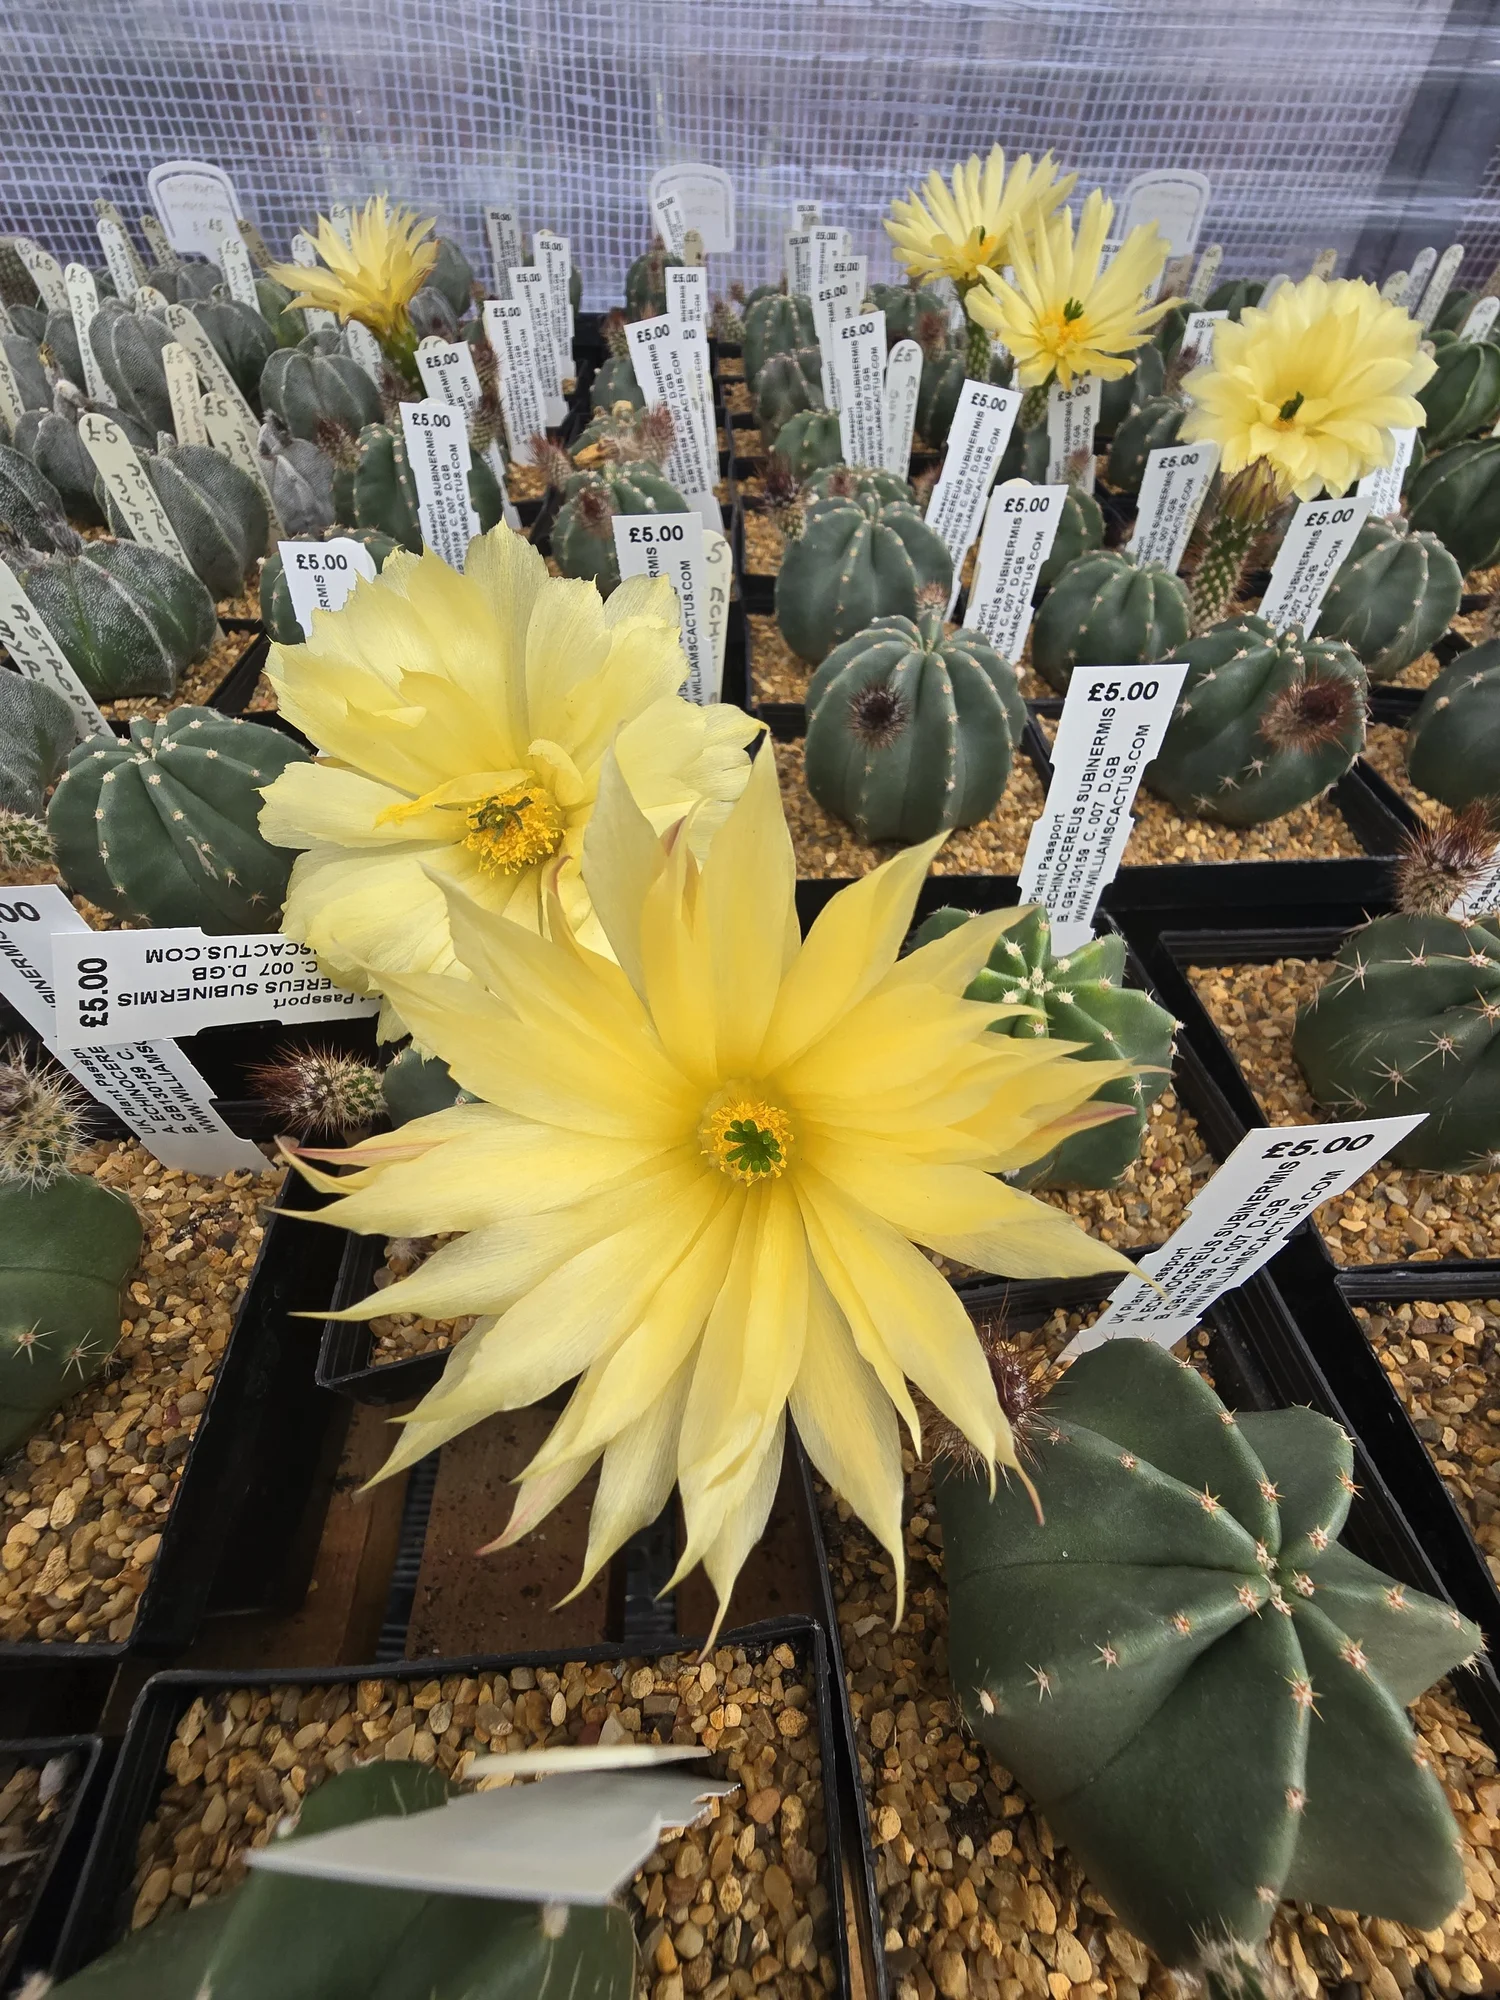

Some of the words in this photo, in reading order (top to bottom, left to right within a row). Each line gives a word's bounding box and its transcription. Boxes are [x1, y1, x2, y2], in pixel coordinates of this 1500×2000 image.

[493, 307, 521, 318] £5.00
[636, 324, 670, 343] £5.00
[841, 322, 875, 339] £5.00
[426, 352, 459, 369] £5.00
[204, 396, 228, 417] £5
[971, 392, 1007, 412] £5.00
[412, 412, 451, 428] £5.00
[86, 418, 118, 444] £5
[1158, 452, 1199, 470] £5.00
[1004, 497, 1050, 513] £5.00
[1304, 508, 1355, 527] £5.00
[629, 525, 684, 543] £5.00
[296, 553, 348, 571] £5.00
[1088, 681, 1160, 702] £5.00
[1045, 807, 1085, 915] ECHINOCEREUS
[1077, 707, 1116, 803] SUBINERMIS
[1073, 723, 1151, 923] WWW.WILLIAMSCACTUS.COM
[1060, 849, 1090, 911] GB130159
[1090, 802, 1106, 825] 007
[1099, 756, 1120, 793] D.GB
[192, 964, 247, 981] D.GB
[259, 962, 294, 976] 007
[301, 961, 318, 973] C.
[77, 957, 108, 1028] £5.00
[117, 981, 258, 1007] SUBINERMIS
[272, 993, 354, 1009] Passport
[116, 1048, 135, 1060] C.
[105, 1090, 141, 1117] Plant
[129, 1066, 187, 1122] GB130159
[132, 1119, 157, 1134] UK
[162, 1124, 179, 1135] A.
[182, 1124, 199, 1134] B.
[1261, 1134, 1375, 1159] £5.00
[1131, 1314, 1150, 1322] A.
[1213, 1160, 1301, 1238] SUBINERMIS
[1175, 1169, 1345, 1319] WWW.WILLIAMSCACTUS.COM
[1153, 1311, 1173, 1320] B.
[1164, 1268, 1218, 1311] GB130159
[1211, 1253, 1234, 1264] C.
[1224, 1235, 1252, 1252] 007
[1246, 1199, 1290, 1229] D.GB
[1107, 1311, 1131, 1325] UK
[1119, 1289, 1152, 1311] Plant
